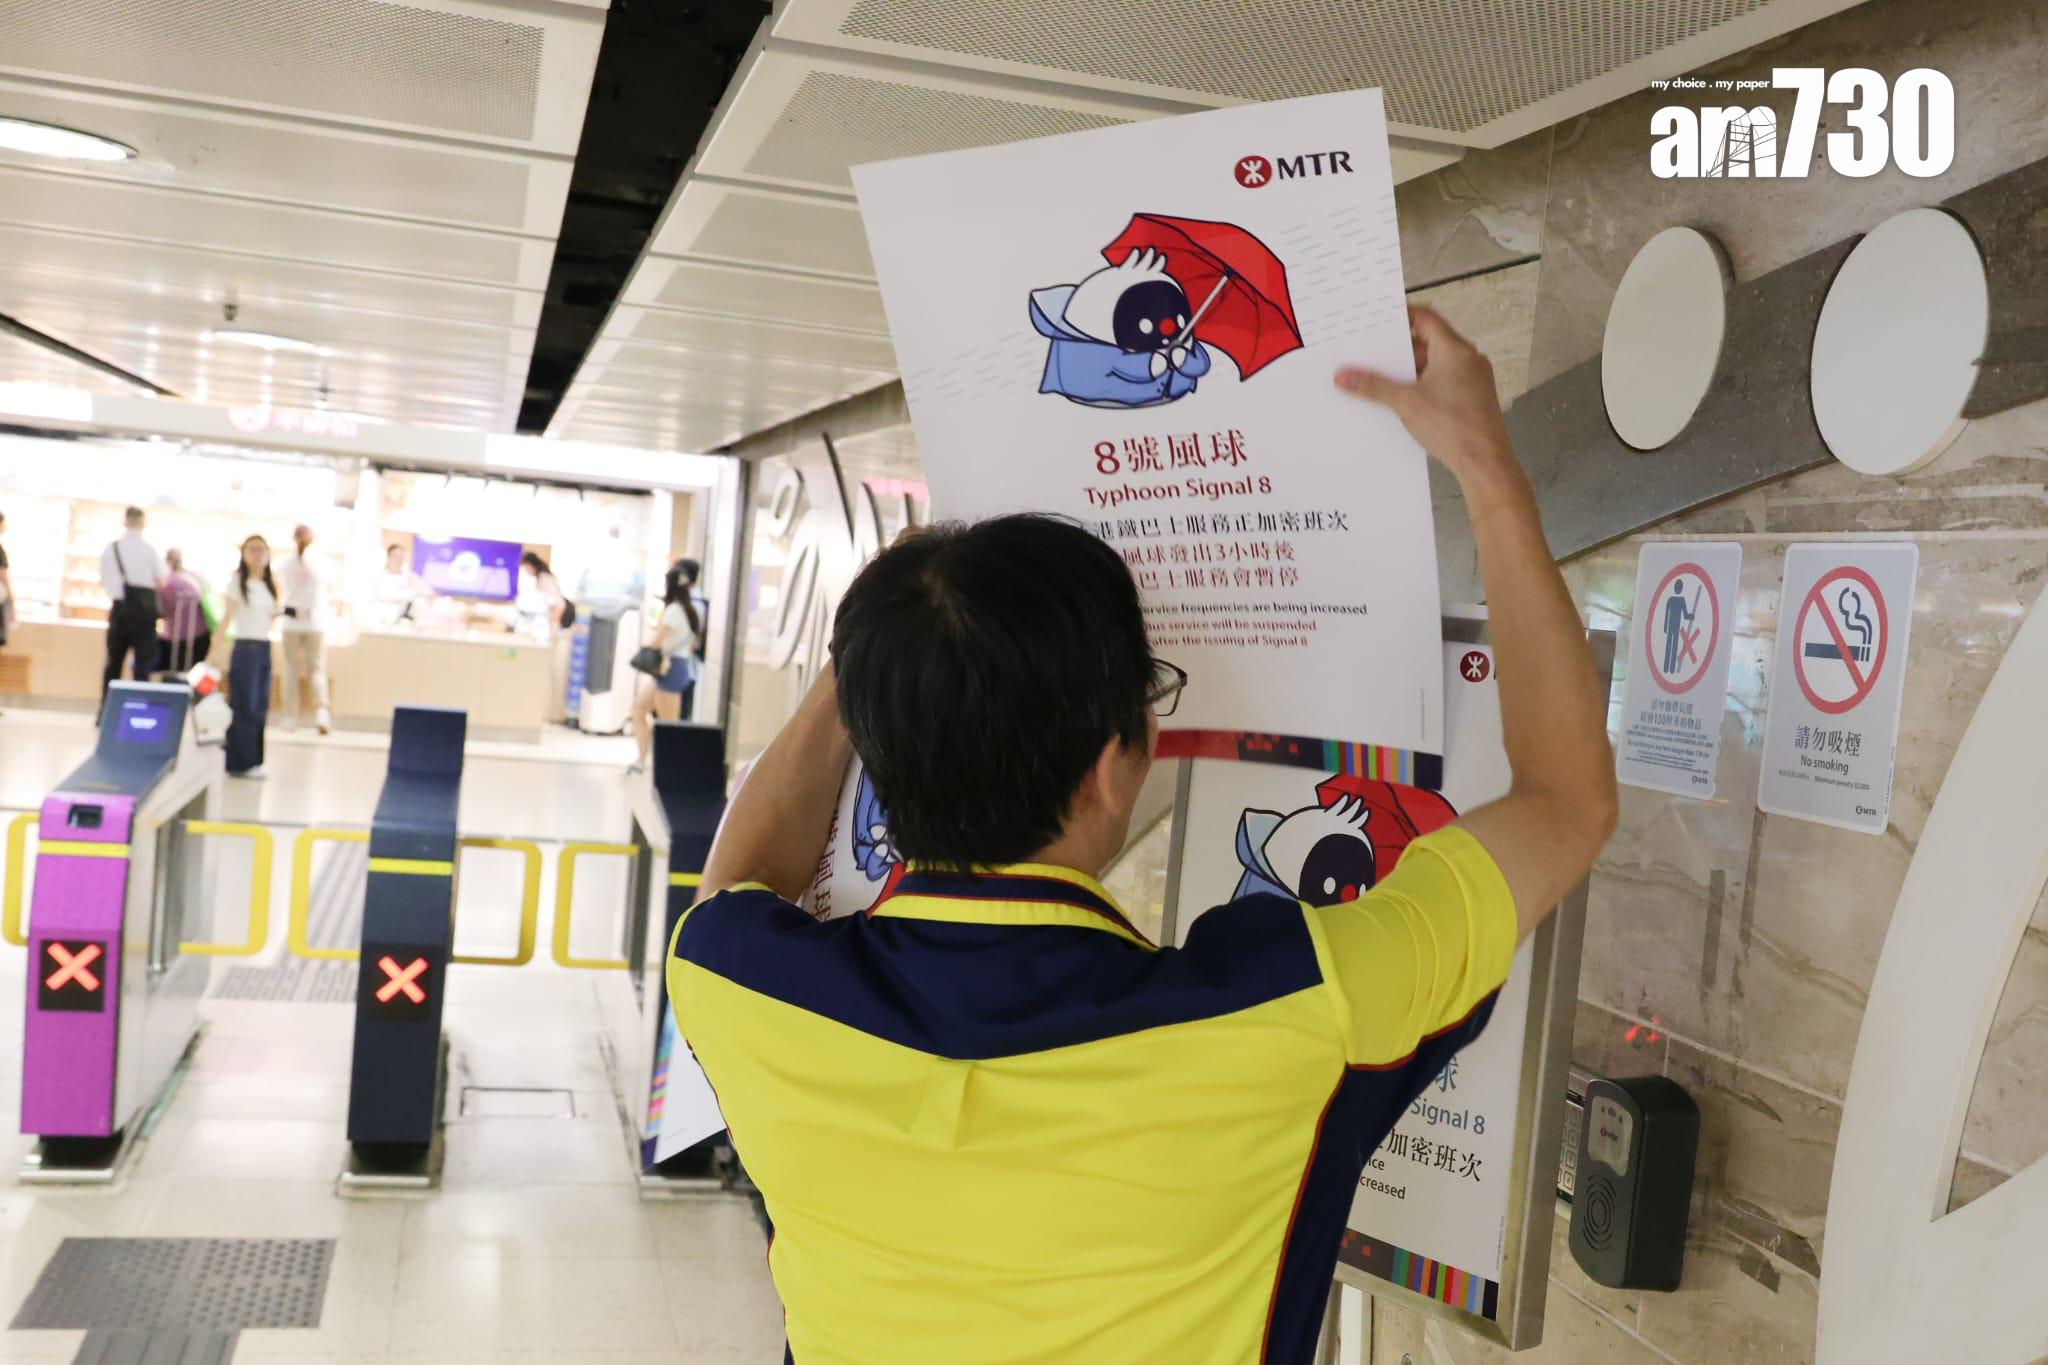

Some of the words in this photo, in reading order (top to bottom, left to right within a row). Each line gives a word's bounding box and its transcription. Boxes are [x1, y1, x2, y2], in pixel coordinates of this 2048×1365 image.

[1276, 150, 1354, 180] MTR
[1094, 428, 1249, 475] 8號風球
[1083, 483, 1180, 509] Typhoon
[1186, 475, 1253, 501] Signal
[1258, 475, 1272, 494] 8
[1142, 604, 1178, 615] ervice
[1181, 602, 1250, 615] frequencies
[1253, 604, 1270, 613] are
[1272, 602, 1308, 615] being
[1309, 602, 1368, 615] increased
[1168, 621, 1208, 631] service
[1211, 618, 1232, 630] will
[1234, 618, 1249, 630] be
[1252, 618, 1317, 632] suspended
[1181, 634, 1202, 646] the
[1203, 635, 1245, 649] issuing
[1247, 635, 1259, 646] of
[1262, 634, 1298, 649] Signal
[1794, 724, 1862, 757] 請勿吸煙
[1800, 755, 1812, 768] No
[1813, 757, 1849, 776] smoking
[1410, 1096, 1469, 1130] Signal
[1473, 1115, 1486, 1135] 8
[1379, 1128, 1482, 1182] 加密班次
[1360, 1175, 1406, 1200] creased
